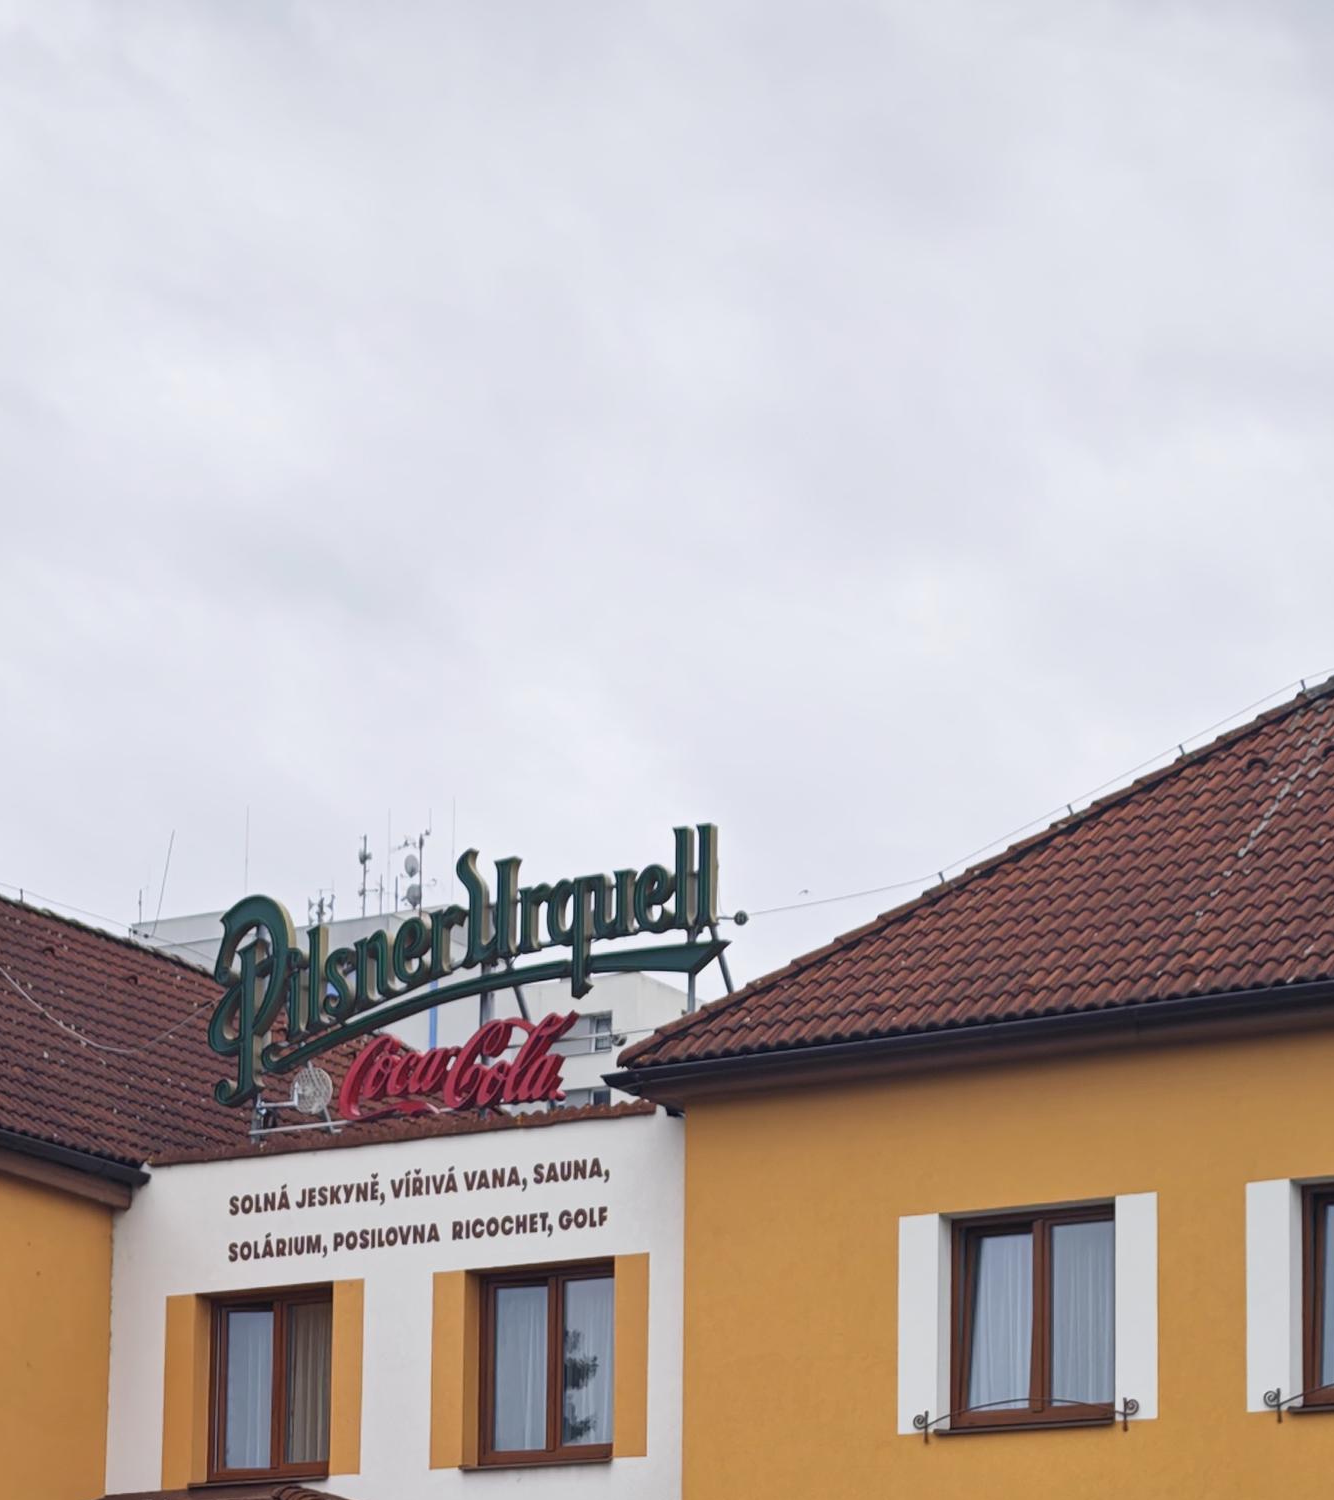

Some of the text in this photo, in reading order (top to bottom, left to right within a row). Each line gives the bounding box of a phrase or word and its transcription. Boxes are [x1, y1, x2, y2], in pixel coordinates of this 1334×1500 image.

[208, 823, 718, 1106] Pilsner Urquell
[228, 1157, 611, 1215] SOLNÁ JESKYNĚ, VÍŘIVÁ VANA, SAUNA,
[228, 1206, 609, 1263] SOLÁRIUM, POSILOVNA RICOCHET, GOLF
